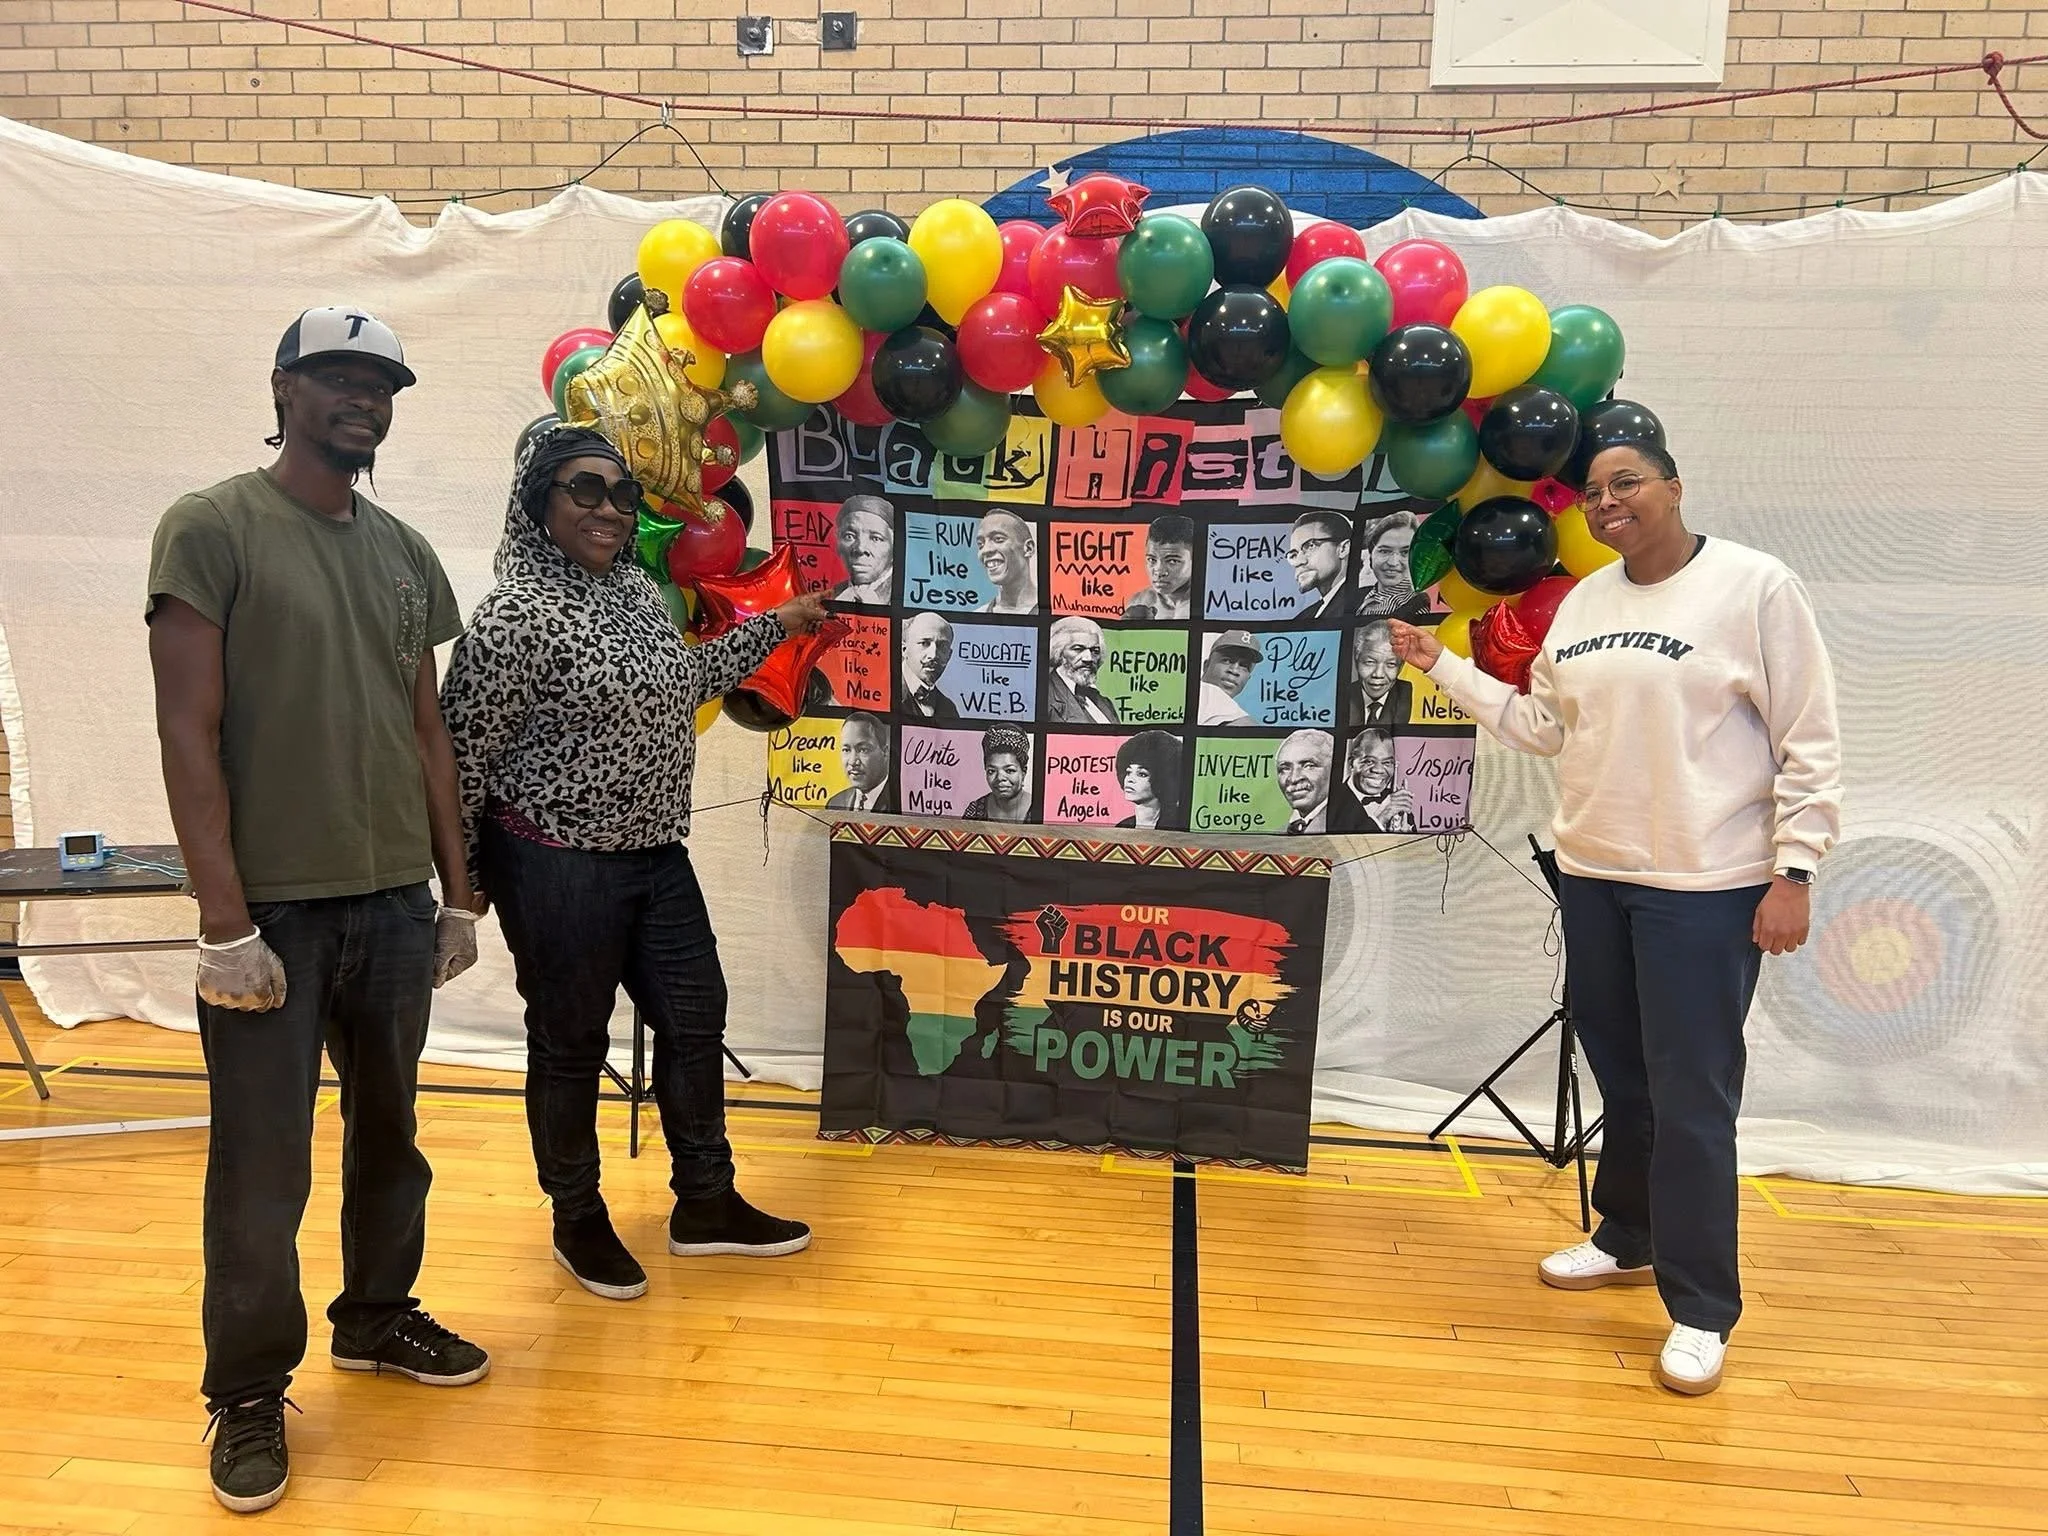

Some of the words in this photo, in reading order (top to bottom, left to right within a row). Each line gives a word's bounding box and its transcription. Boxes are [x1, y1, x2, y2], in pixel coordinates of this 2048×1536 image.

[345, 314, 369, 340] T
[774, 509, 834, 542] LEAD
[936, 521, 975, 548] RUN
[1056, 530, 1134, 562] FIGHT
[928, 550, 969, 579] like
[1232, 564, 1274, 583] like
[910, 577, 979, 606] Jesse
[1082, 576, 1114, 597] like
[1053, 594, 1126, 616] Muhammad
[1206, 590, 1296, 613] Malcolm
[872, 622, 888, 636] the
[958, 641, 1031, 663] EDUCATE
[1555, 632, 1694, 664] MONTVIEW
[844, 656, 869, 676] like
[1110, 651, 1187, 674] REFORM
[1266, 636, 1332, 689] Play
[982, 667, 1010, 687] like
[1130, 674, 1159, 693] like
[846, 681, 882, 702] Mae
[1260, 679, 1299, 702] like
[960, 691, 1028, 715] W.E.B.
[1115, 696, 1184, 722] Frederick
[1263, 705, 1331, 724] Jackie
[771, 726, 835, 752] Dream
[904, 736, 961, 767] Write
[792, 758, 822, 775] like
[1048, 756, 1116, 775] PROTEST
[1198, 754, 1274, 779] INVENT
[770, 777, 828, 803] Martin
[924, 773, 952, 791] like
[1072, 778, 1100, 796] like
[1218, 784, 1250, 804] like
[908, 790, 953, 817] Maya
[1429, 785, 1462, 805] like
[1057, 797, 1110, 824] Angela
[1196, 805, 1266, 833] George
[1120, 904, 1169, 925] OUR
[1074, 923, 1231, 967] BLACK
[1049, 960, 1242, 1010] HISTORY
[1103, 1009, 1122, 1028] IS
[1127, 1011, 1173, 1034] OUR
[1034, 1027, 1236, 1089] POWER
